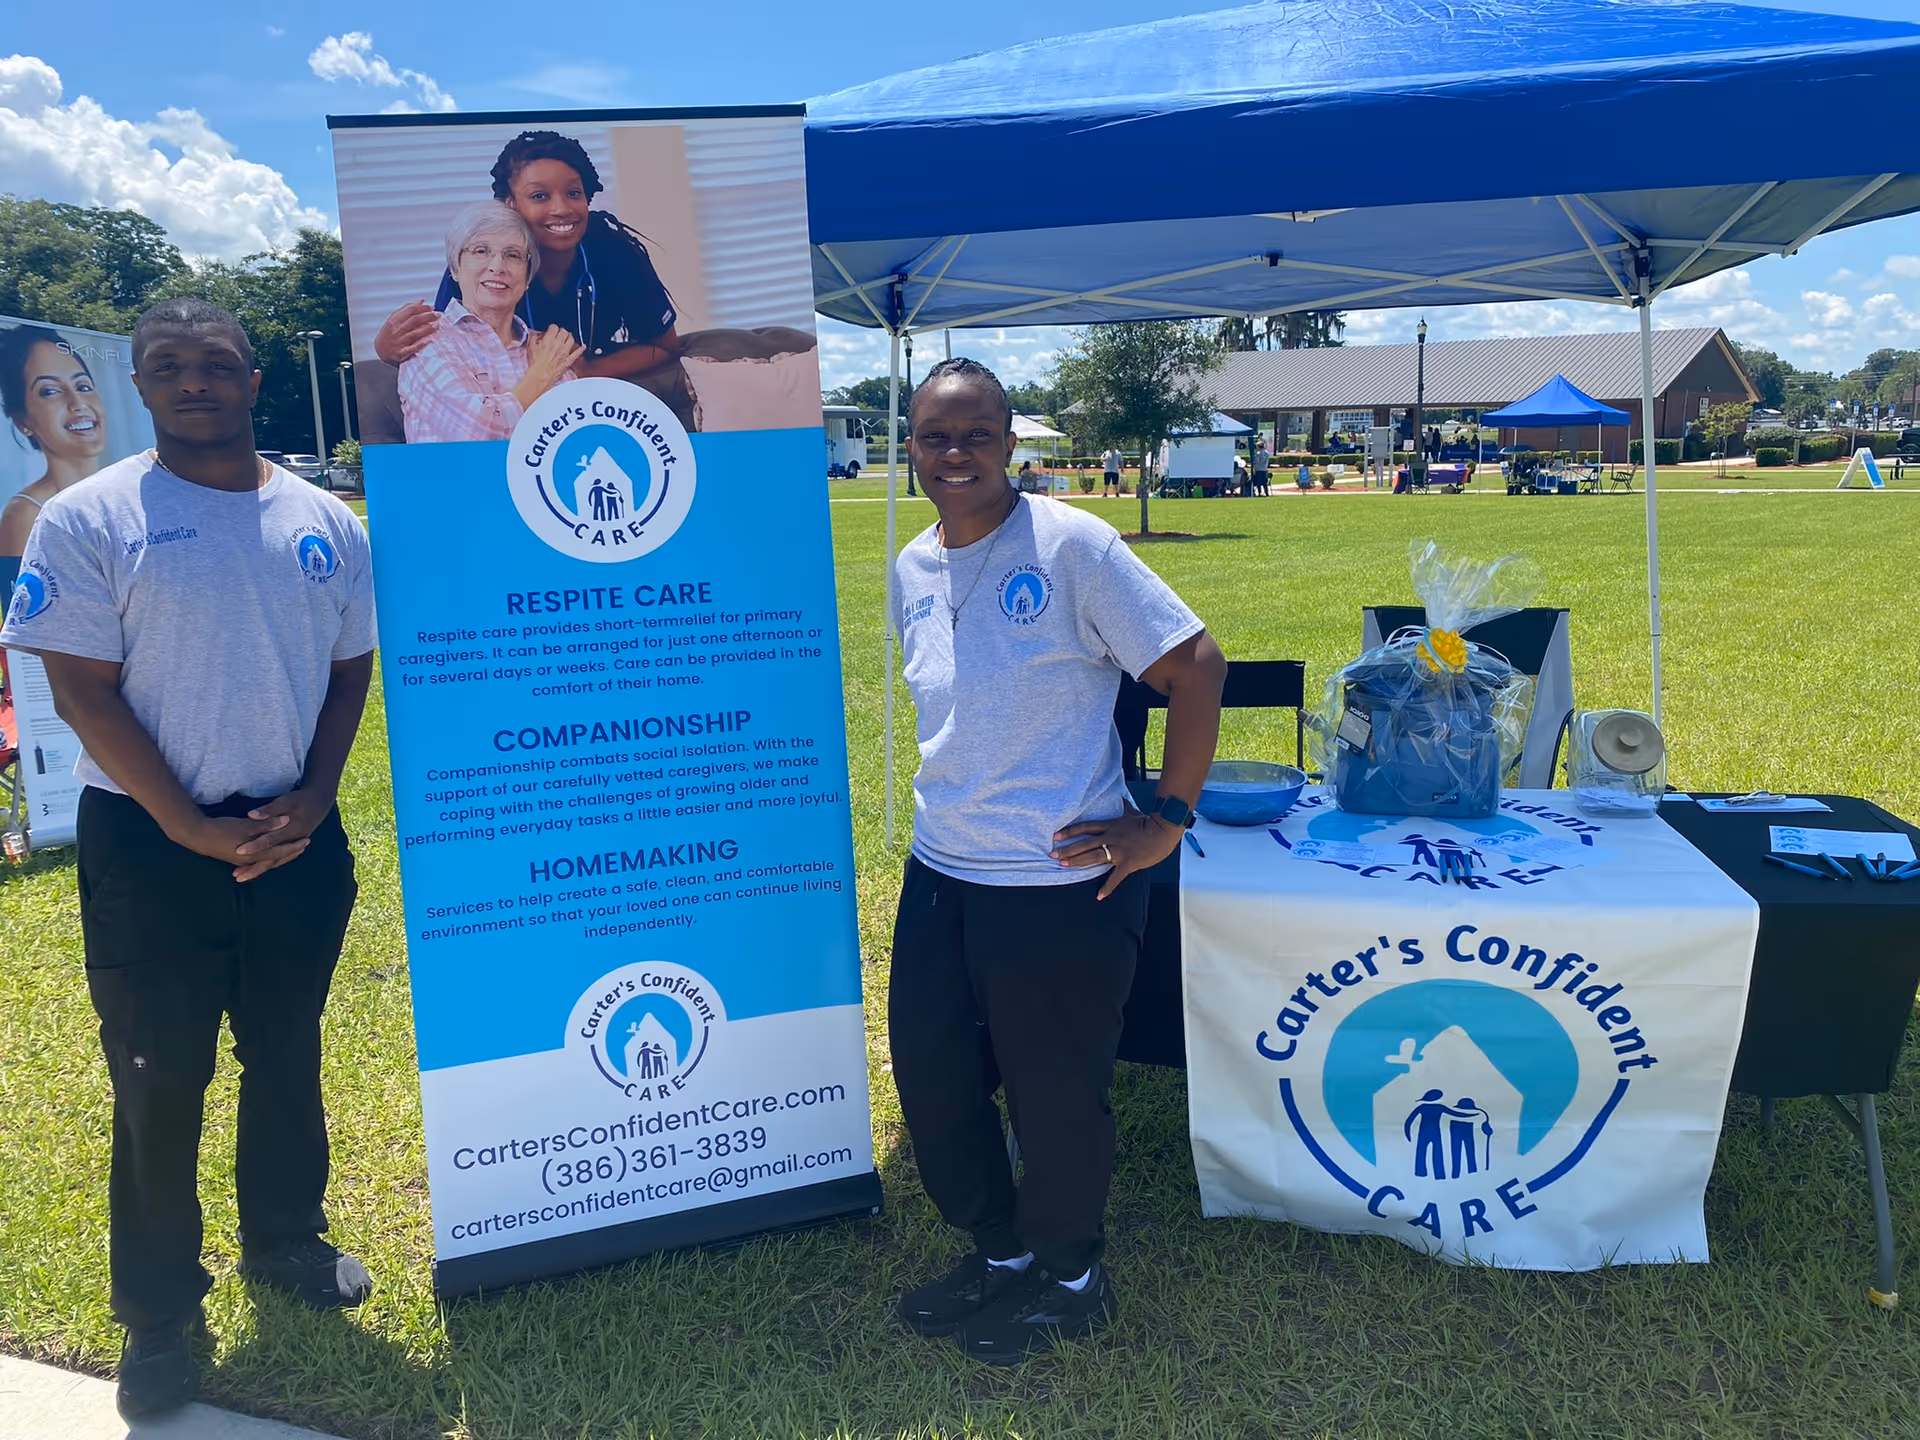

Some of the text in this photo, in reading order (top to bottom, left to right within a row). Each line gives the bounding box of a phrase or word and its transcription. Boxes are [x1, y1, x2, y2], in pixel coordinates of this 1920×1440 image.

[56, 342, 130, 364] SKINFU
[525, 401, 677, 468] Carter's Confident
[181, 526, 198, 539] Care
[574, 521, 644, 546] CARE
[29, 560, 59, 598] Confident
[305, 570, 327, 584] CARE
[996, 563, 1053, 592] Carter's Confident
[507, 582, 712, 615] RESPITE CARE
[418, 610, 802, 645] Respite care provides short-termrelief for primary
[1008, 615, 1036, 625] CARE
[399, 629, 822, 666] caregivers. It can be arranged for just one afternoon or
[402, 647, 821, 686] for several days or weeks. Care can be provided in the
[532, 676, 704, 696] comfort of their home.
[494, 710, 751, 752] COMPANIONSHIP
[427, 737, 814, 782] Companionship combats social isolation. With the
[425, 756, 818, 804] support of our carefully vetted caregivers, we make
[440, 774, 808, 823] coping with the challenges of growing older and
[404, 792, 843, 850] performing everyday tasks a little easier and more joyful.
[1500, 798, 1604, 833] ident
[530, 839, 738, 883] HOMEMAKING
[1360, 865, 1545, 890] CARE
[427, 860, 834, 918] Services to help create a safe, clean, and comfortable
[422, 879, 841, 940] environment so that your loved one can continue living
[584, 914, 697, 938] independently.
[581, 973, 716, 1039] Carter's Confident
[1256, 925, 1658, 1073] Carter's Confident
[624, 1075, 686, 1101] CARE
[452, 1084, 845, 1170] CartersConfidentCare.com
[541, 1126, 767, 1195] (386)361-3839
[451, 1145, 852, 1240] cartersconfidentcare@gmail.com
[1367, 1177, 1538, 1240] CARE
